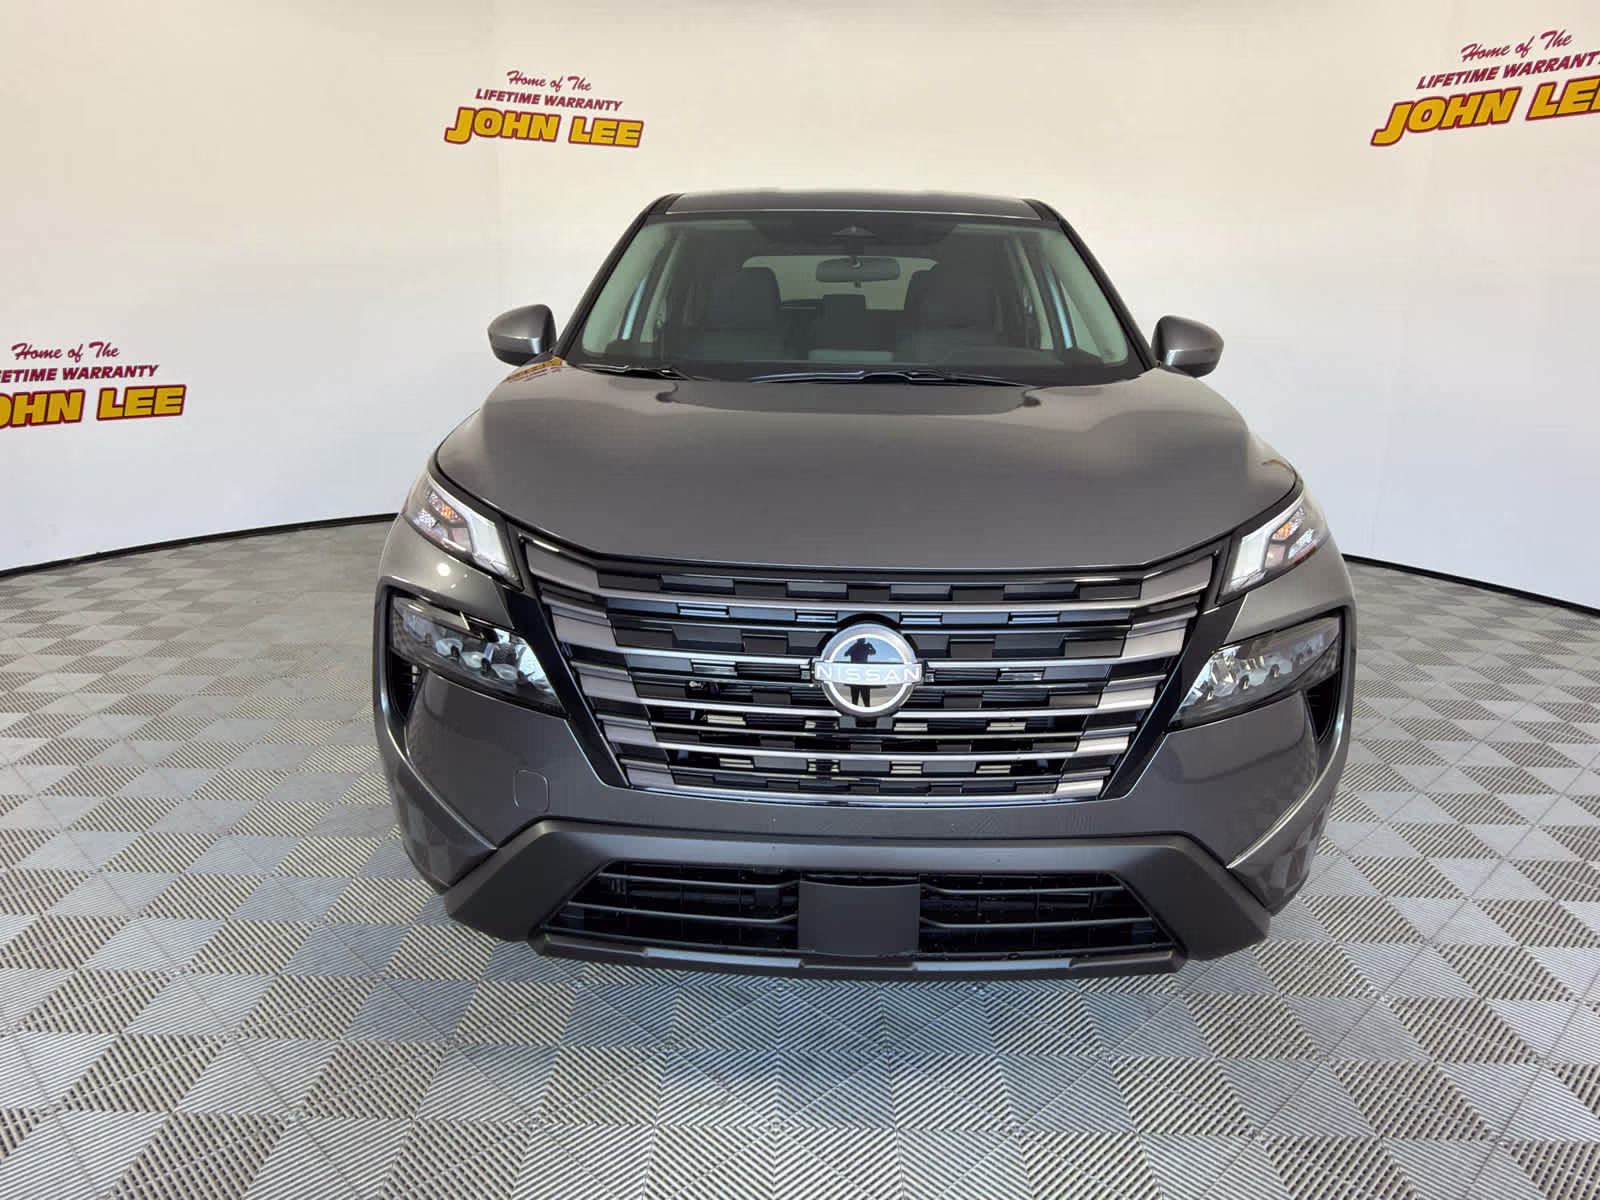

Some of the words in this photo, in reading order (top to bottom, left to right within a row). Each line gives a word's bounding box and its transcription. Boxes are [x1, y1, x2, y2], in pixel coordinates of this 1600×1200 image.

[1460, 43, 1510, 62] Home
[1515, 36, 1535, 58] of
[1540, 29, 1572, 50] The
[507, 70, 546, 87] Home
[550, 76, 563, 93] of
[567, 76, 592, 91] The
[1416, 66, 1500, 90] LIFETIME
[1502, 50, 1600, 79] WARRANT
[475, 88, 541, 105] LIFETIME
[544, 95, 623, 111] WARRANTY
[444, 106, 561, 144] JOHN
[568, 116, 644, 148] LEE
[1369, 86, 1522, 147] JOHN
[11, 343, 63, 360] Home
[67, 344, 83, 363] of
[89, 341, 120, 358] The
[0, 368, 58, 383] ETIME
[62, 364, 160, 381] WARRANTY
[96, 384, 187, 421] LEE
[815, 662, 920, 682] NISSAN
